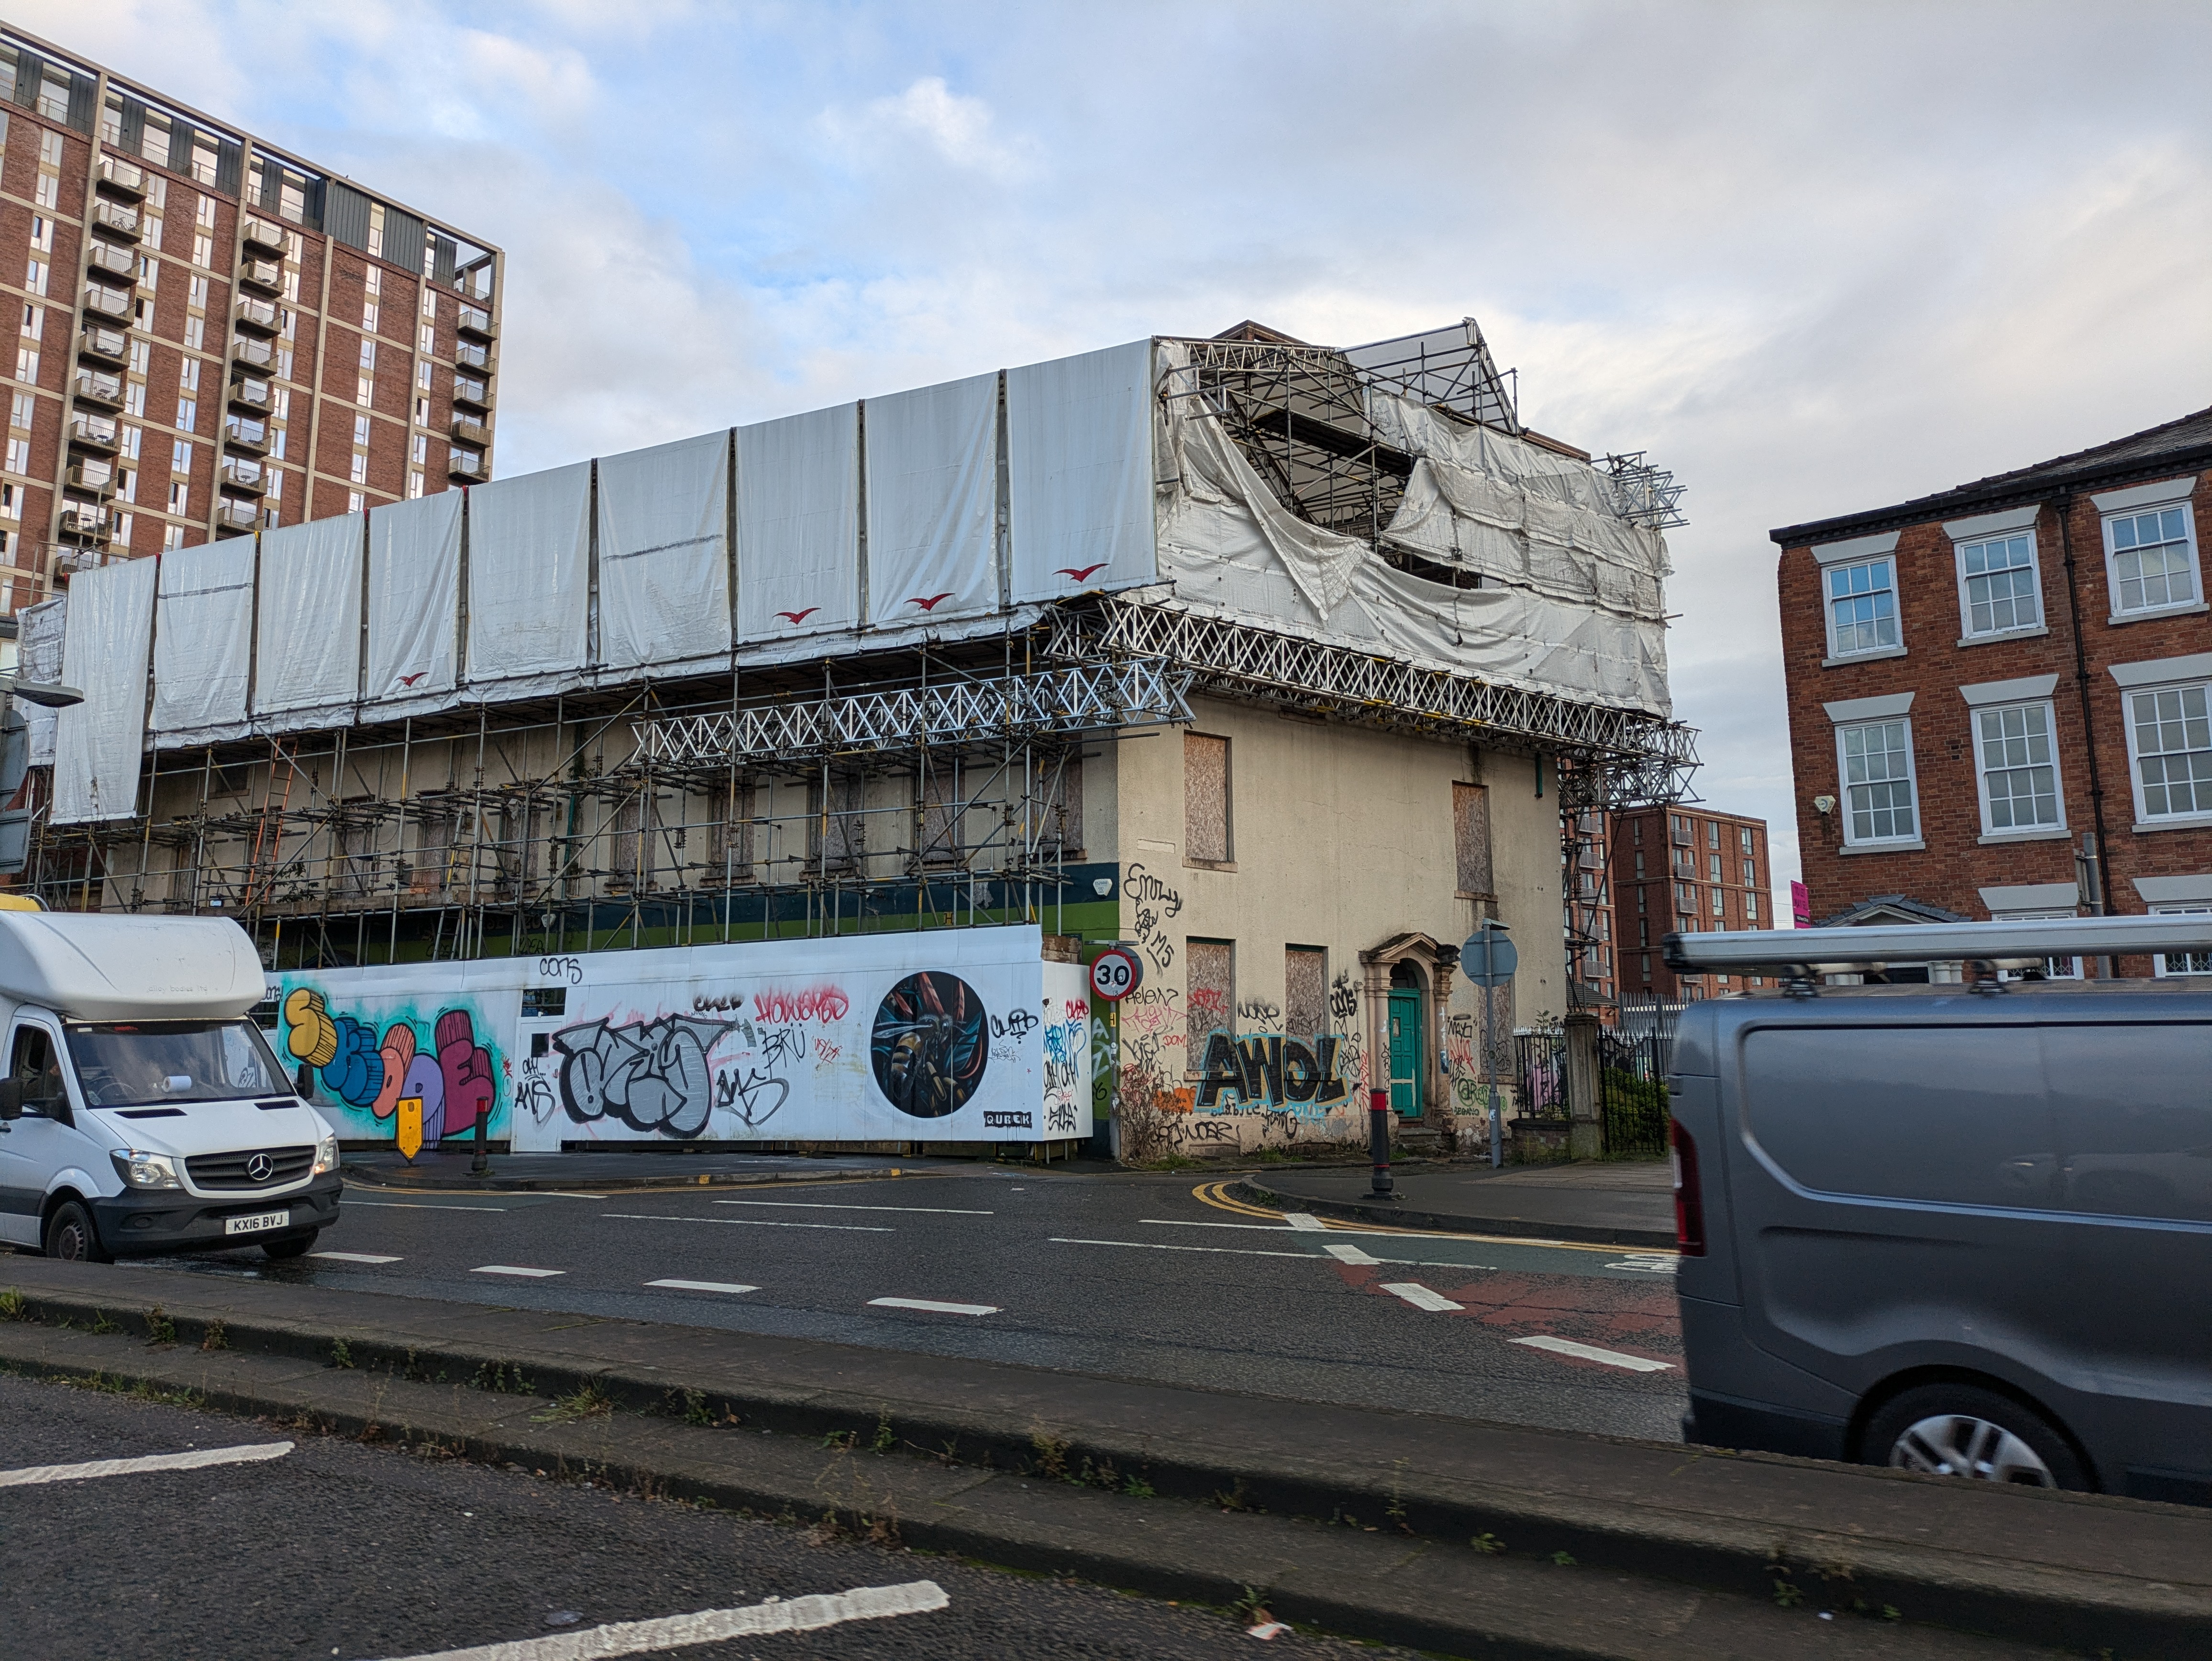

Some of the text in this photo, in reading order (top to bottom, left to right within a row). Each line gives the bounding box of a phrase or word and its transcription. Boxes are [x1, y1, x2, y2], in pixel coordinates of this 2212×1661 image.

[1097, 964, 1129, 986] 30
[234, 1214, 283, 1231] KX16 BVJ
